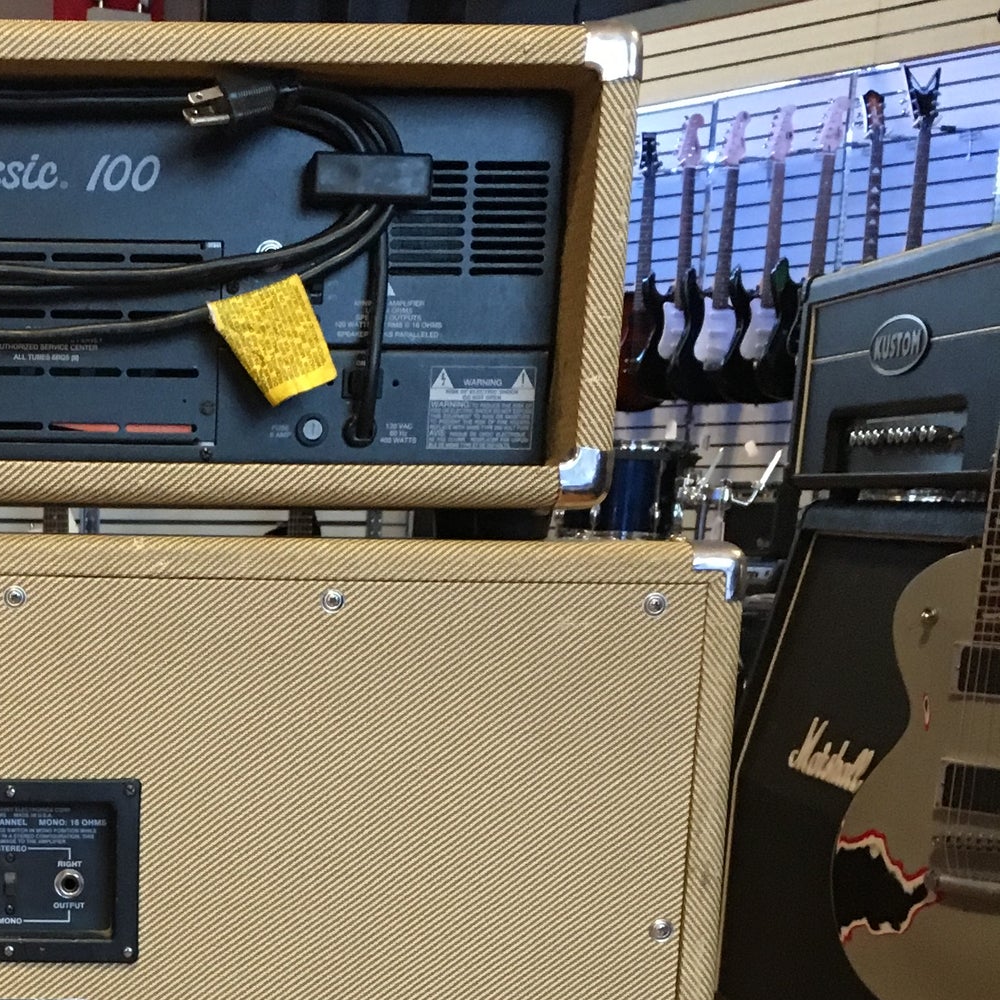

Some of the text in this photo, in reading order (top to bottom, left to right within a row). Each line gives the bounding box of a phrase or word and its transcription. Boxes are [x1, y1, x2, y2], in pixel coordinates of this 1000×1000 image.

[86, 154, 161, 192] 100
[874, 330, 922, 361] KUSTOM
[464, 378, 502, 386] WARNING
[38, 818, 68, 826] MONO:
[82, 818, 107, 826] OHMS
[57, 860, 82, 868] RIGHT
